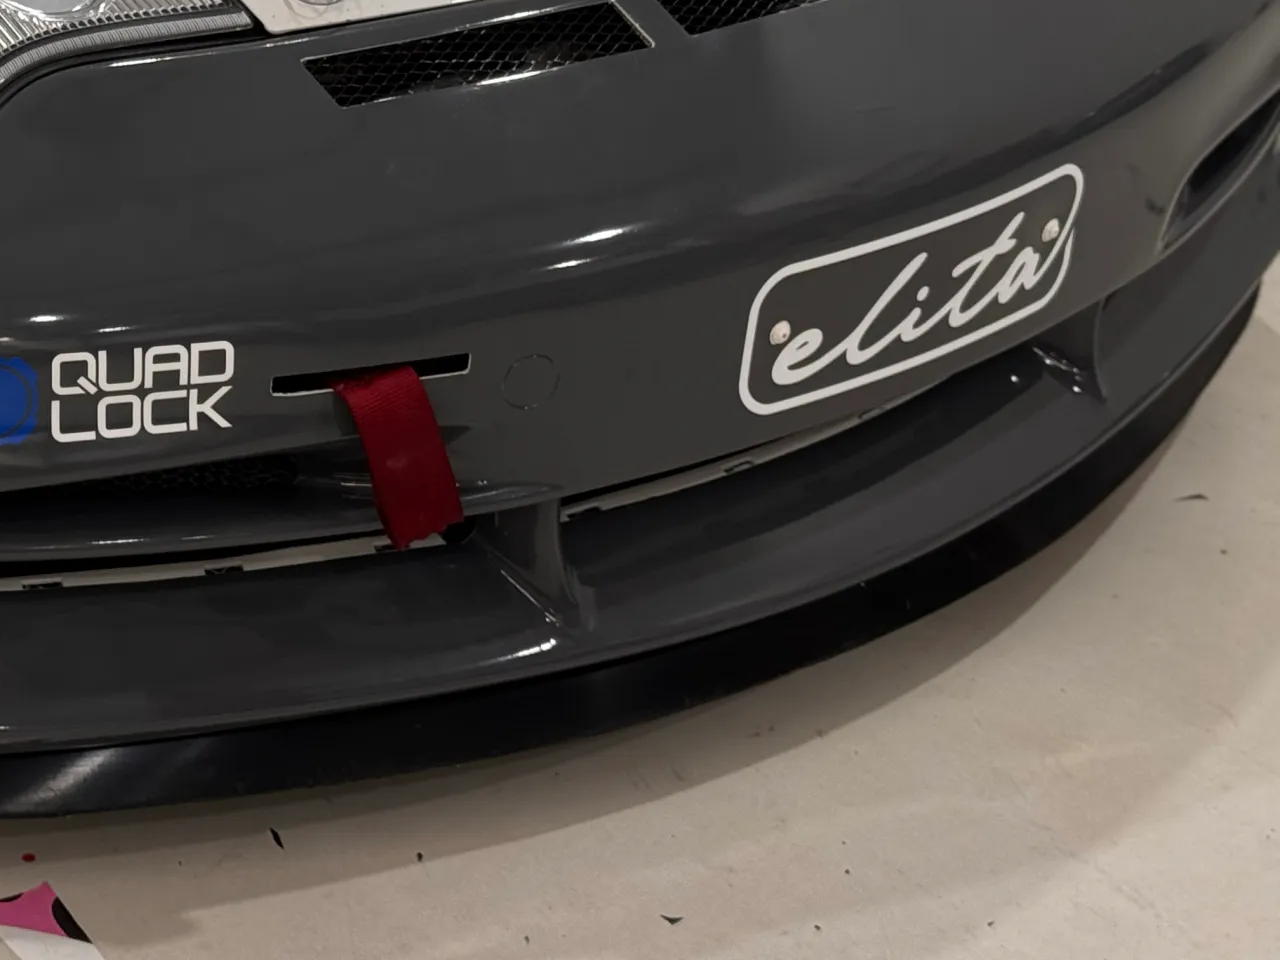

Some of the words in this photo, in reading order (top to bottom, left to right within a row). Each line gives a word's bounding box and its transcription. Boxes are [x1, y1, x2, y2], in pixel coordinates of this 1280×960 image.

[771, 211, 1052, 386] elita
[51, 340, 234, 395] QUAD
[51, 386, 233, 443] LOCK
